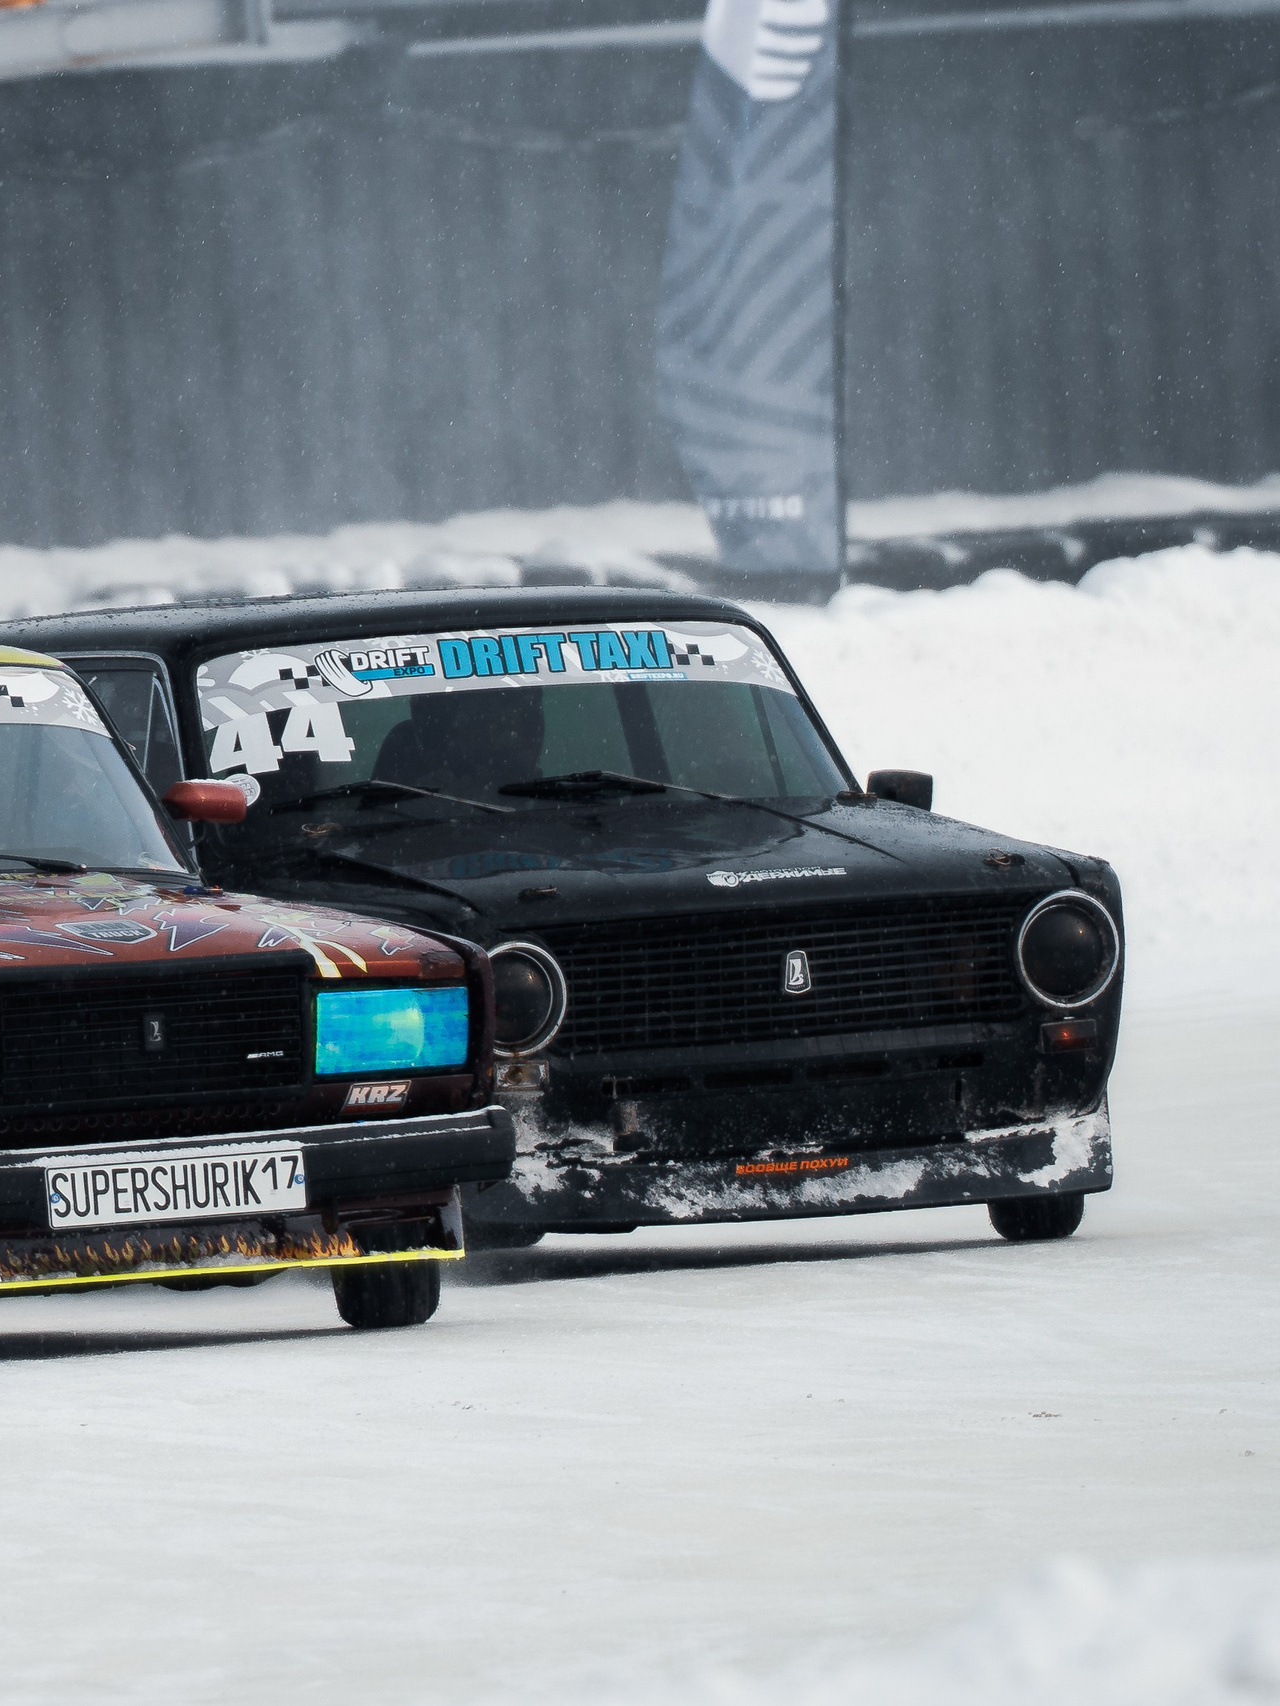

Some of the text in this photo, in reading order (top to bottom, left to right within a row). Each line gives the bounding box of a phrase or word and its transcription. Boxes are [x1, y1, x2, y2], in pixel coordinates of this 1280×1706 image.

[349, 646, 428, 671] DRIFT
[437, 630, 674, 679] DRIFT TAXI
[394, 666, 425, 676] EXPO
[209, 701, 356, 775] 44
[89, 929, 146, 938] TRUCK
[257, 1050, 284, 1058] AMG
[347, 1084, 408, 1105] KRZ
[735, 1161, 798, 1174] ВООБЩЕ
[51, 1155, 300, 1219] SUPERSHURIK 17
